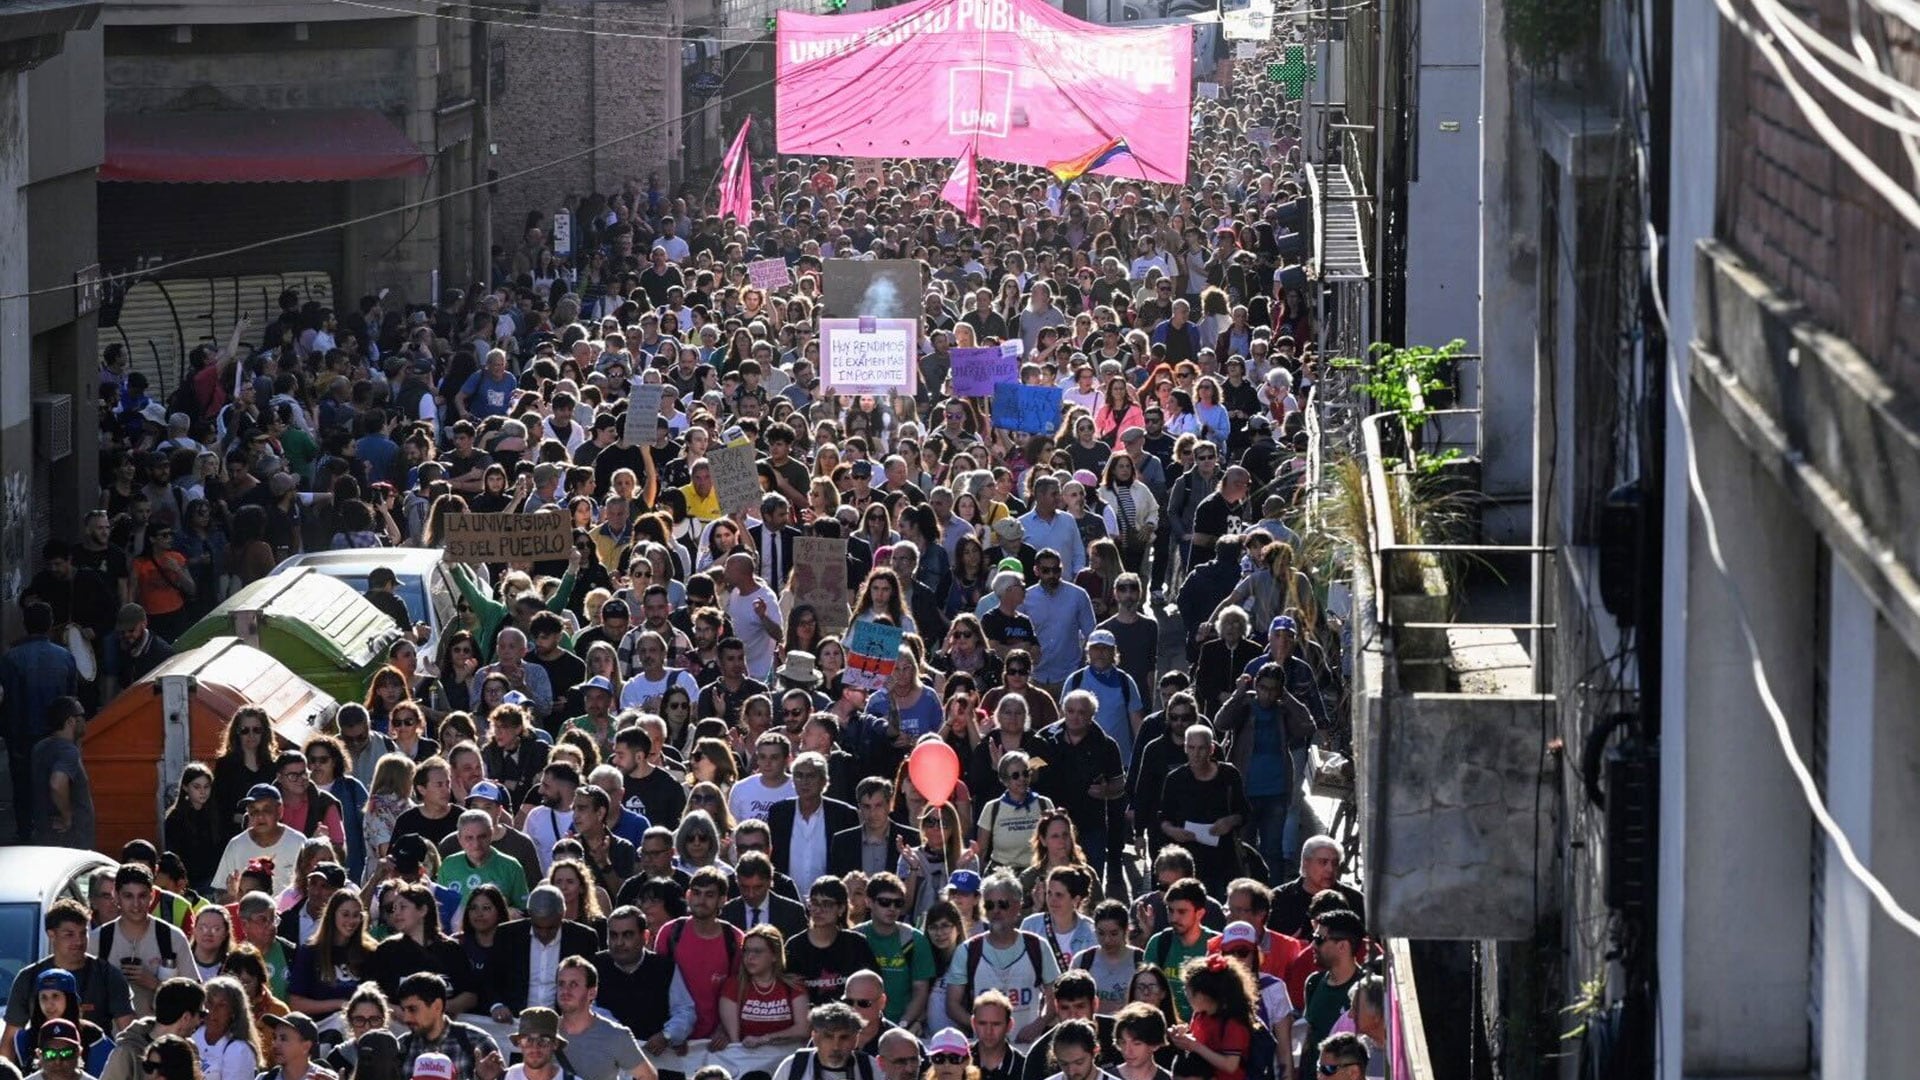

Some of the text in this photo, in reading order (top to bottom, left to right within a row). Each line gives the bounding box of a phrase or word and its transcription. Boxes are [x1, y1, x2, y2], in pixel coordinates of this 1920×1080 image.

[961, 110, 998, 128] UNR
[853, 339, 905, 354] RENDIMOS
[449, 513, 561, 532] LA UNIVERSIDAD
[450, 534, 565, 556] ES DEL PUEBLO
[742, 1005, 791, 1015] MORADA
[745, 998, 788, 1009] FRANJA
